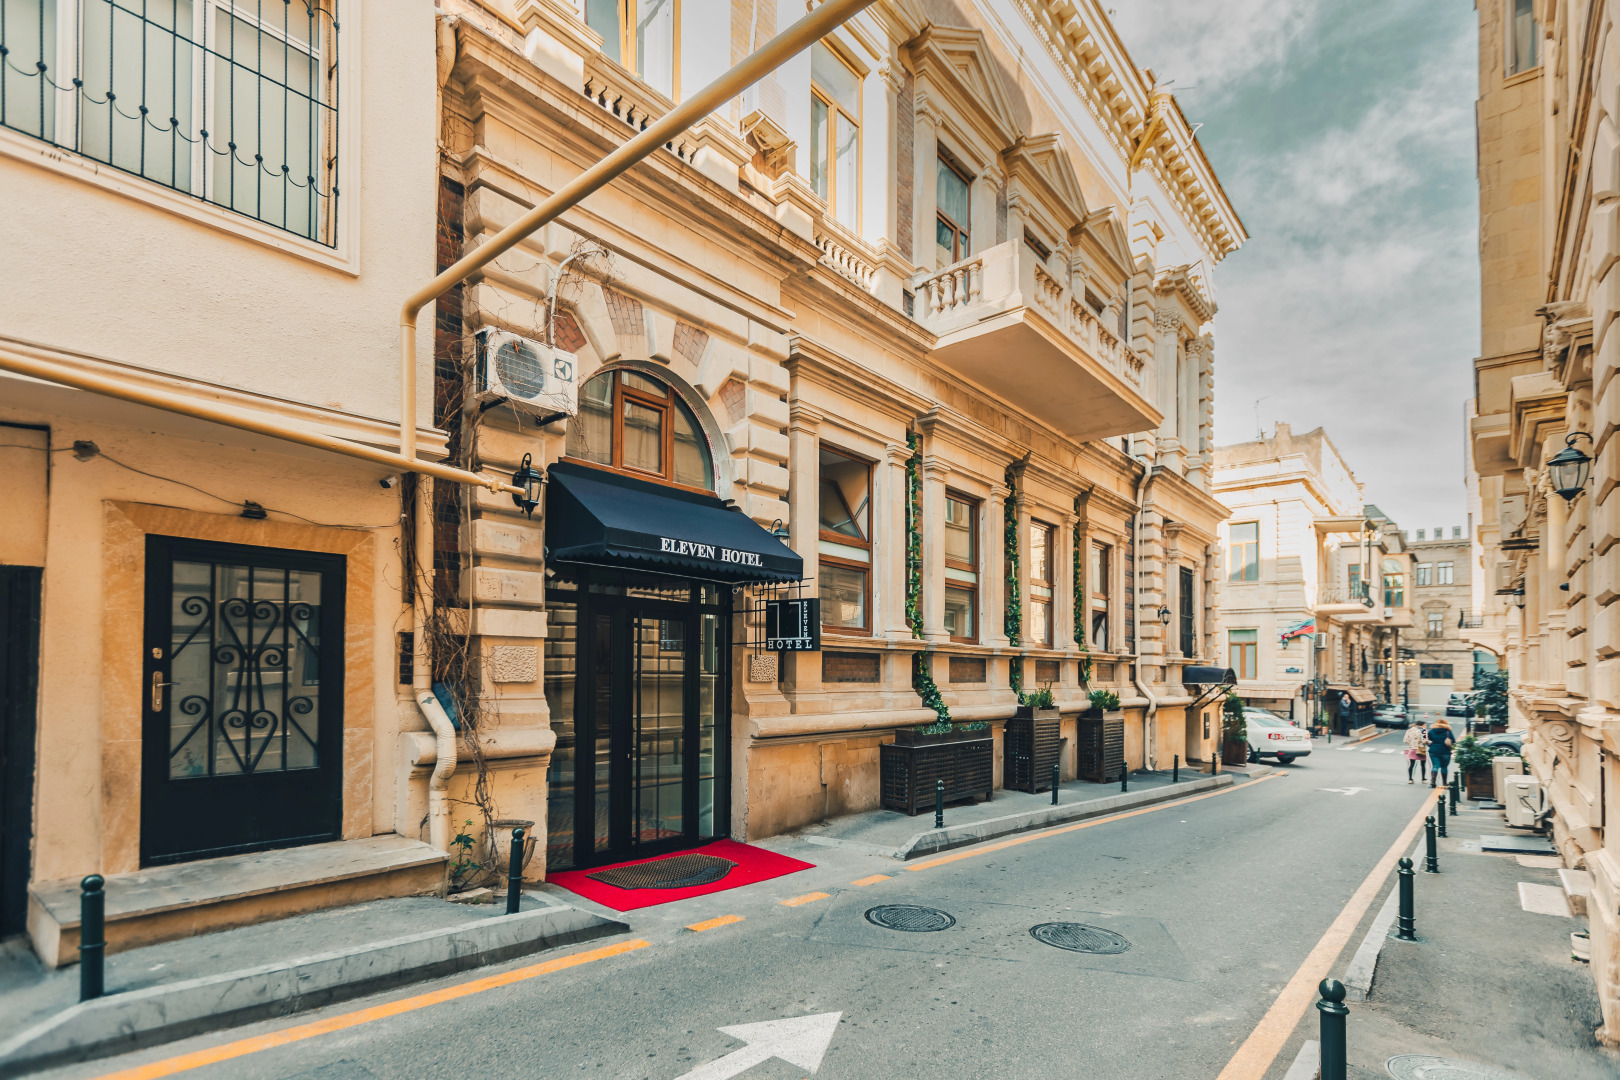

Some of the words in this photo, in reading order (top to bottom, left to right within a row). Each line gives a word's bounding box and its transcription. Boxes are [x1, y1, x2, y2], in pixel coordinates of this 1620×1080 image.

[660, 537, 716, 560] ELEVEN
[720, 548, 763, 567] HOTEL
[767, 639, 813, 650] HOTEL
